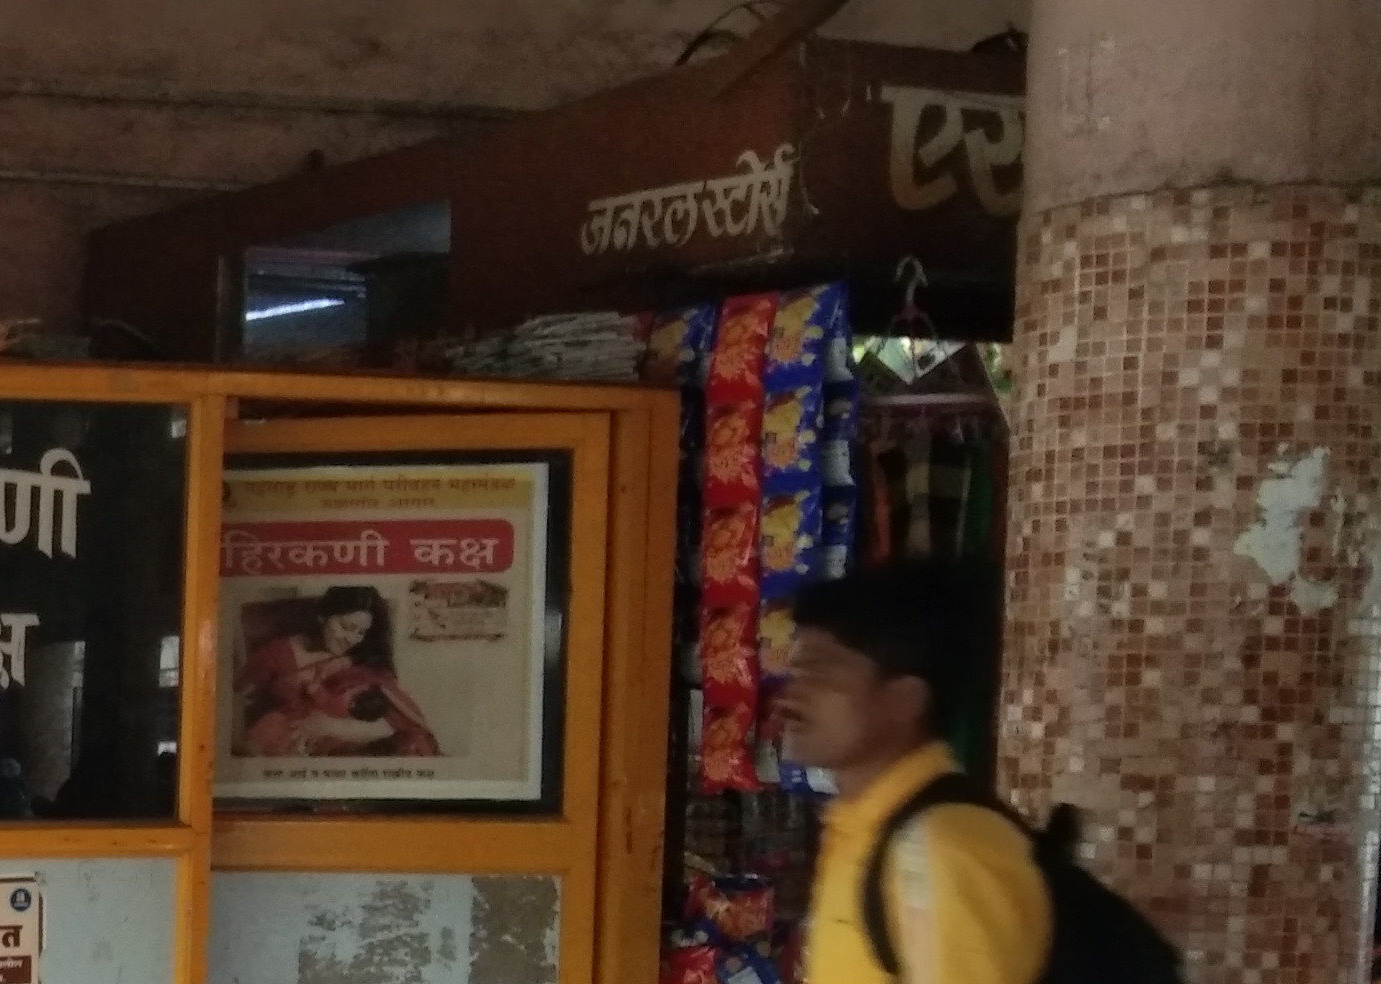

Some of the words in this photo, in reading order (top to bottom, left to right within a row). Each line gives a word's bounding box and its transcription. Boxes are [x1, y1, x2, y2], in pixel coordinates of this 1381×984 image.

[581, 178, 703, 255] जनरल
[220, 529, 390, 575] हिरकणी
[409, 537, 500, 571] कक्ष
